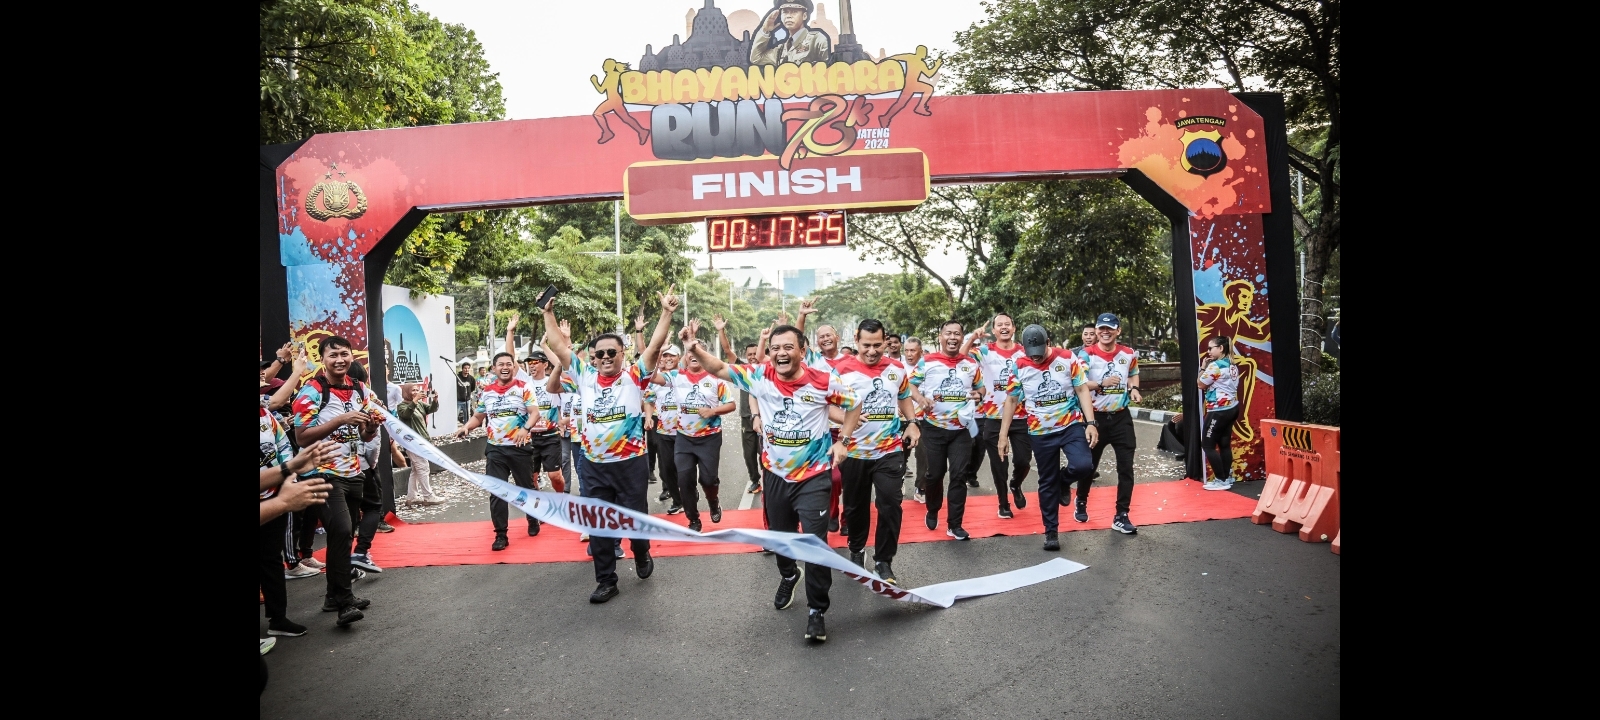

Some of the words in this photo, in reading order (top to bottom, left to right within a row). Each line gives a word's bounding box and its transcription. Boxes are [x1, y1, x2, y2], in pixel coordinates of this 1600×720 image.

[621, 58, 905, 104] BHAYANGKARA
[651, 99, 785, 159] RUN
[857, 127, 890, 139] JATENG
[1176, 118, 1195, 128] JAWA
[1195, 117, 1225, 126] TENGAH
[864, 139, 889, 149] 2024
[692, 166, 862, 200] FINISH
[709, 214, 843, 250] 00:17:25
[568, 501, 637, 531] FINISH
